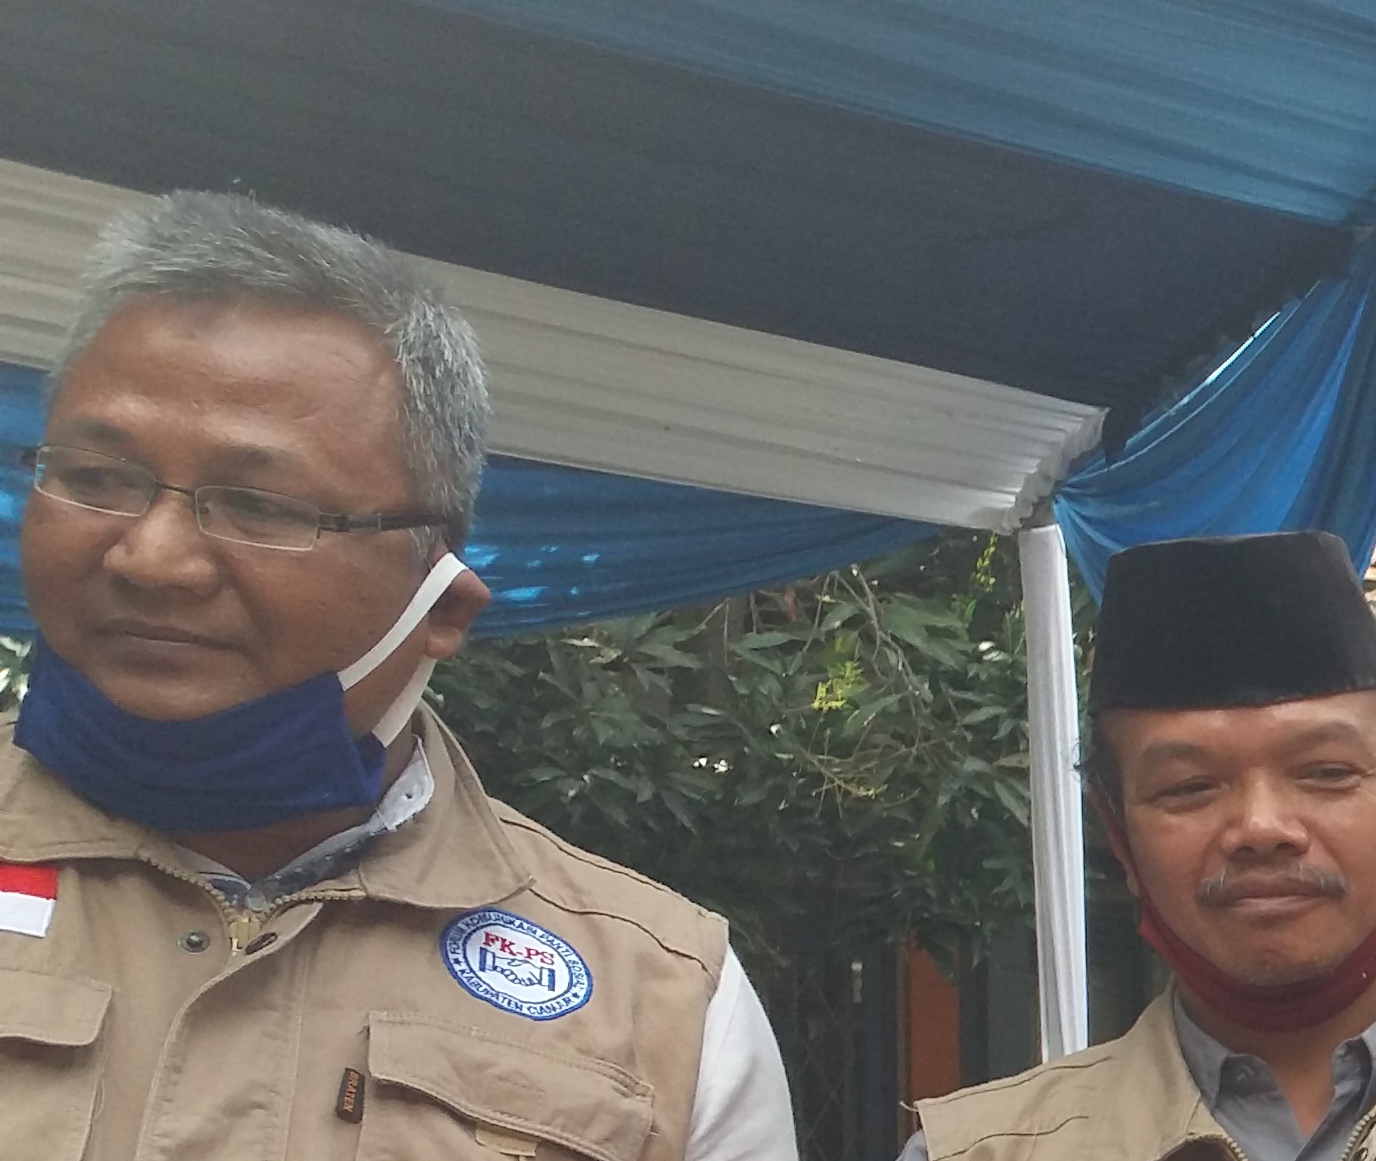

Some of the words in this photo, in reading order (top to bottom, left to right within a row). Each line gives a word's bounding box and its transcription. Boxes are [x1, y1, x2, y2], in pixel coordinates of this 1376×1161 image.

[483, 931, 555, 966] FK-PS
[539, 931, 574, 957] PANTI
[459, 968, 523, 1012] KABUPATEN
